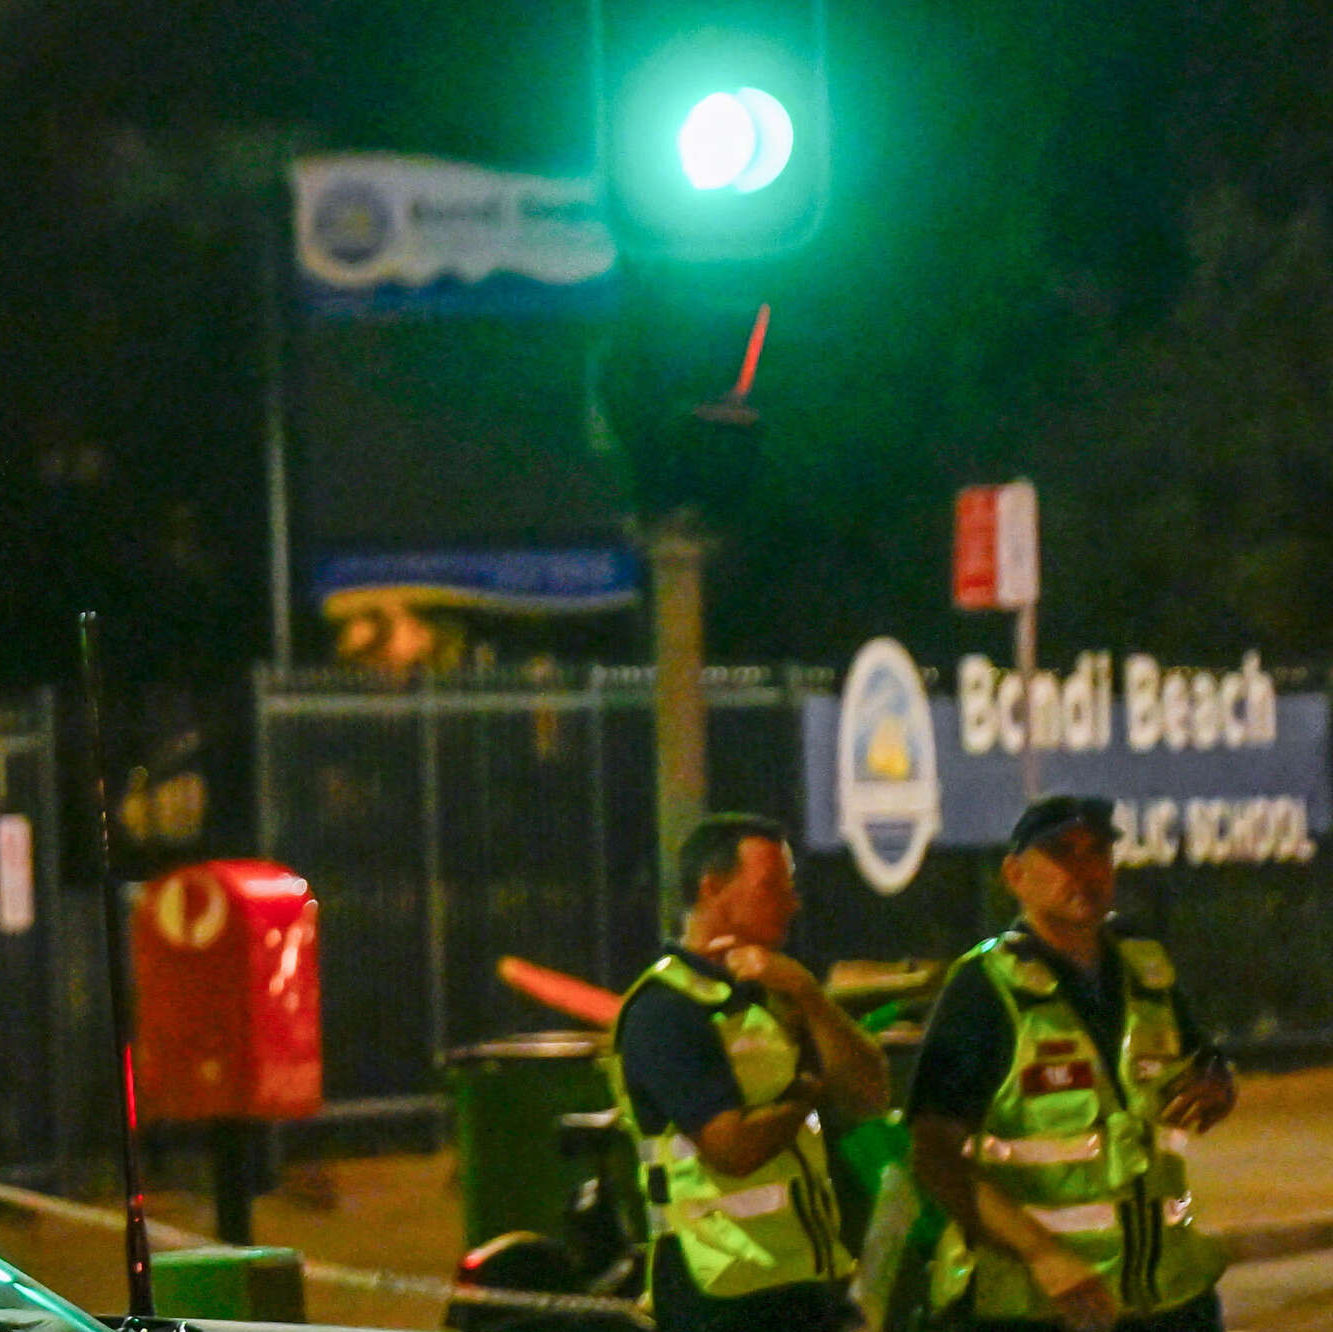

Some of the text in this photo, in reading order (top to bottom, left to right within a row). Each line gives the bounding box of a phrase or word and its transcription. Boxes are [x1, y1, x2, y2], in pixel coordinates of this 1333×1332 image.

[957, 649, 1278, 755] Bondi Beach
[1186, 797, 1317, 867] SCHOOL
